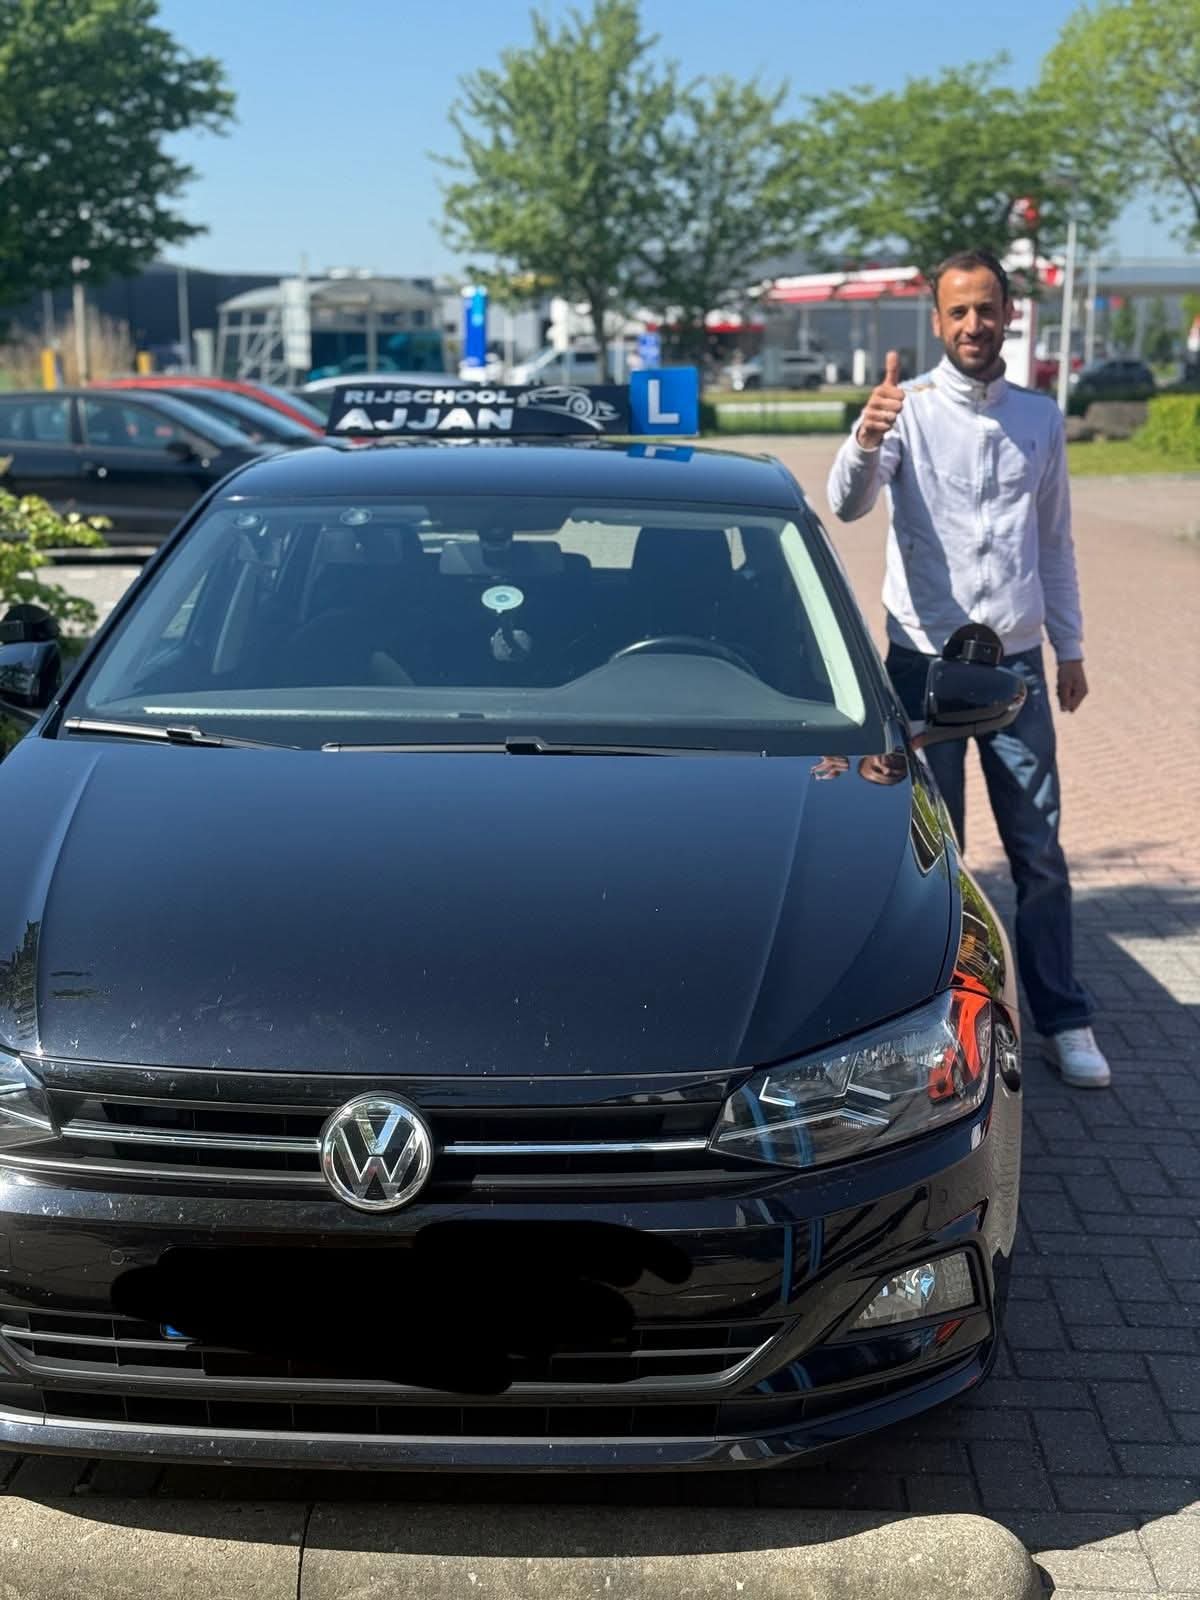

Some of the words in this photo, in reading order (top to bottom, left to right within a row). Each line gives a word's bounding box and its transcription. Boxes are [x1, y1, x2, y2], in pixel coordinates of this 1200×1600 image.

[344, 390, 515, 404] RIJSCHOOL
[648, 379, 680, 424] L
[335, 408, 514, 431] AJJAN
